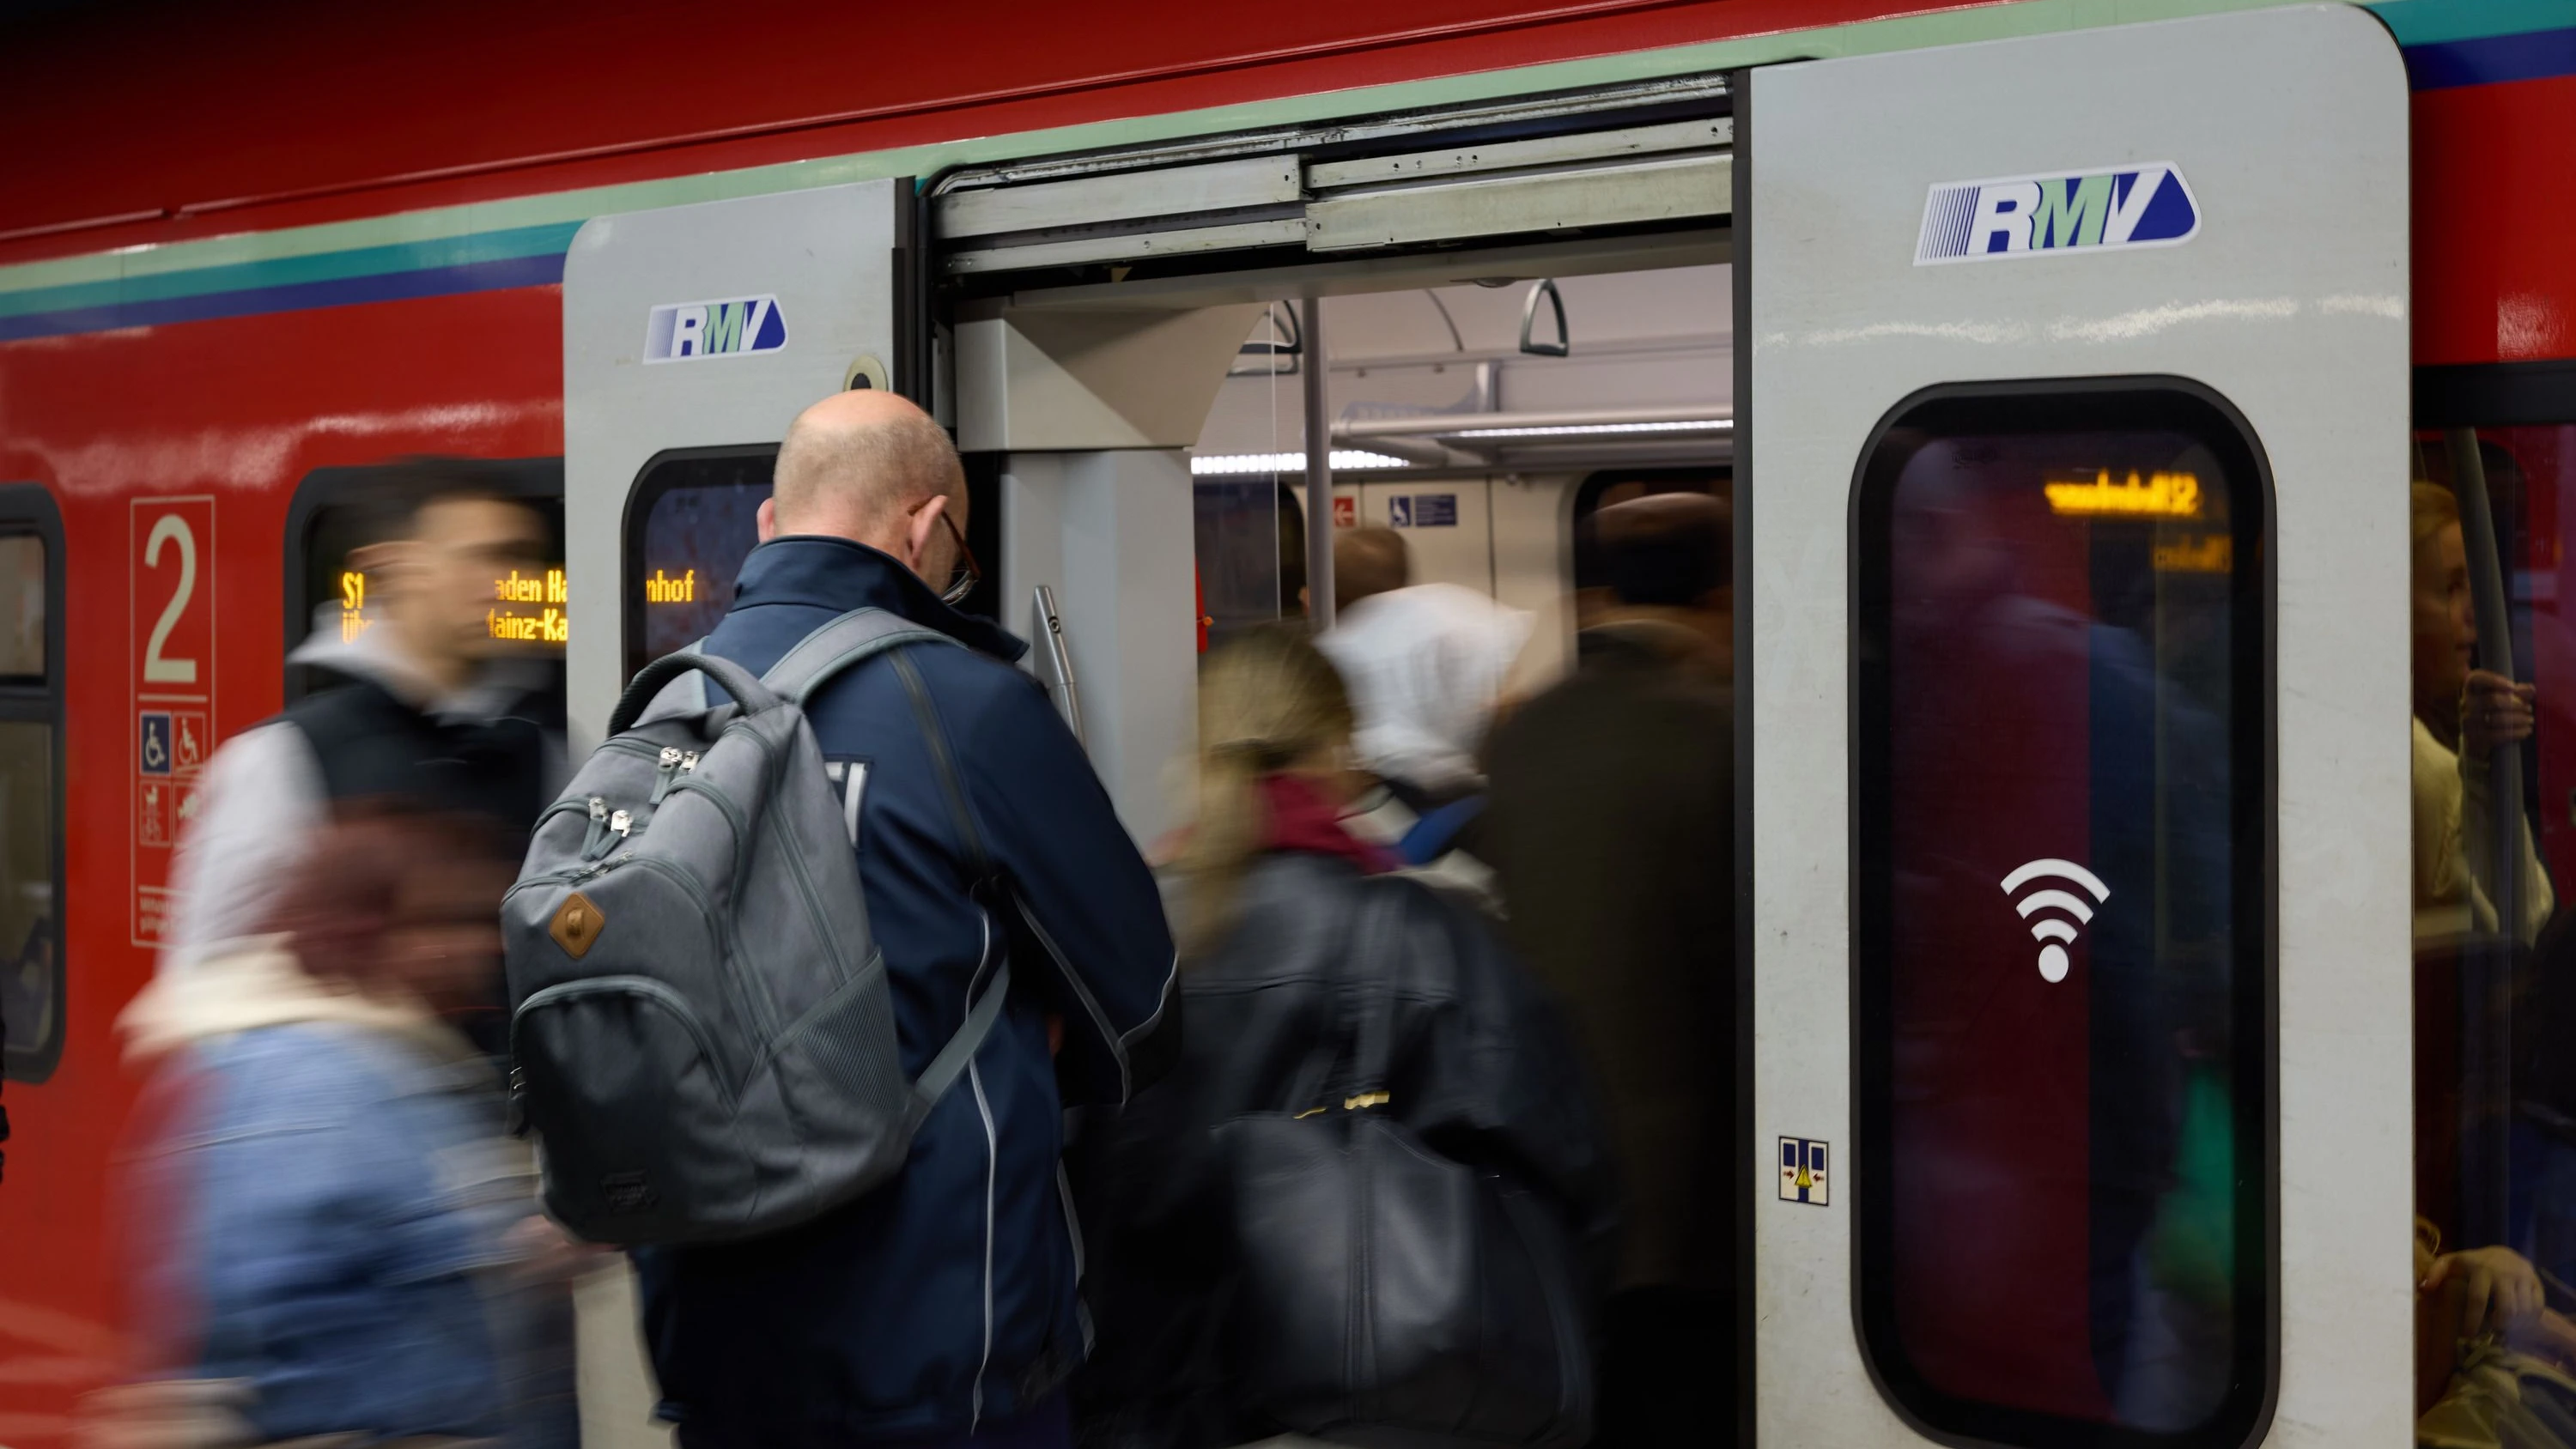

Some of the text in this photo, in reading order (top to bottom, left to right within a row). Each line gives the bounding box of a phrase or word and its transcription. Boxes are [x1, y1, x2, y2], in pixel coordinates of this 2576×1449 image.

[1965, 167, 2169, 256] RMV
[670, 299, 773, 358] RMV
[143, 513, 197, 683] 2
[343, 572, 365, 609] S1
